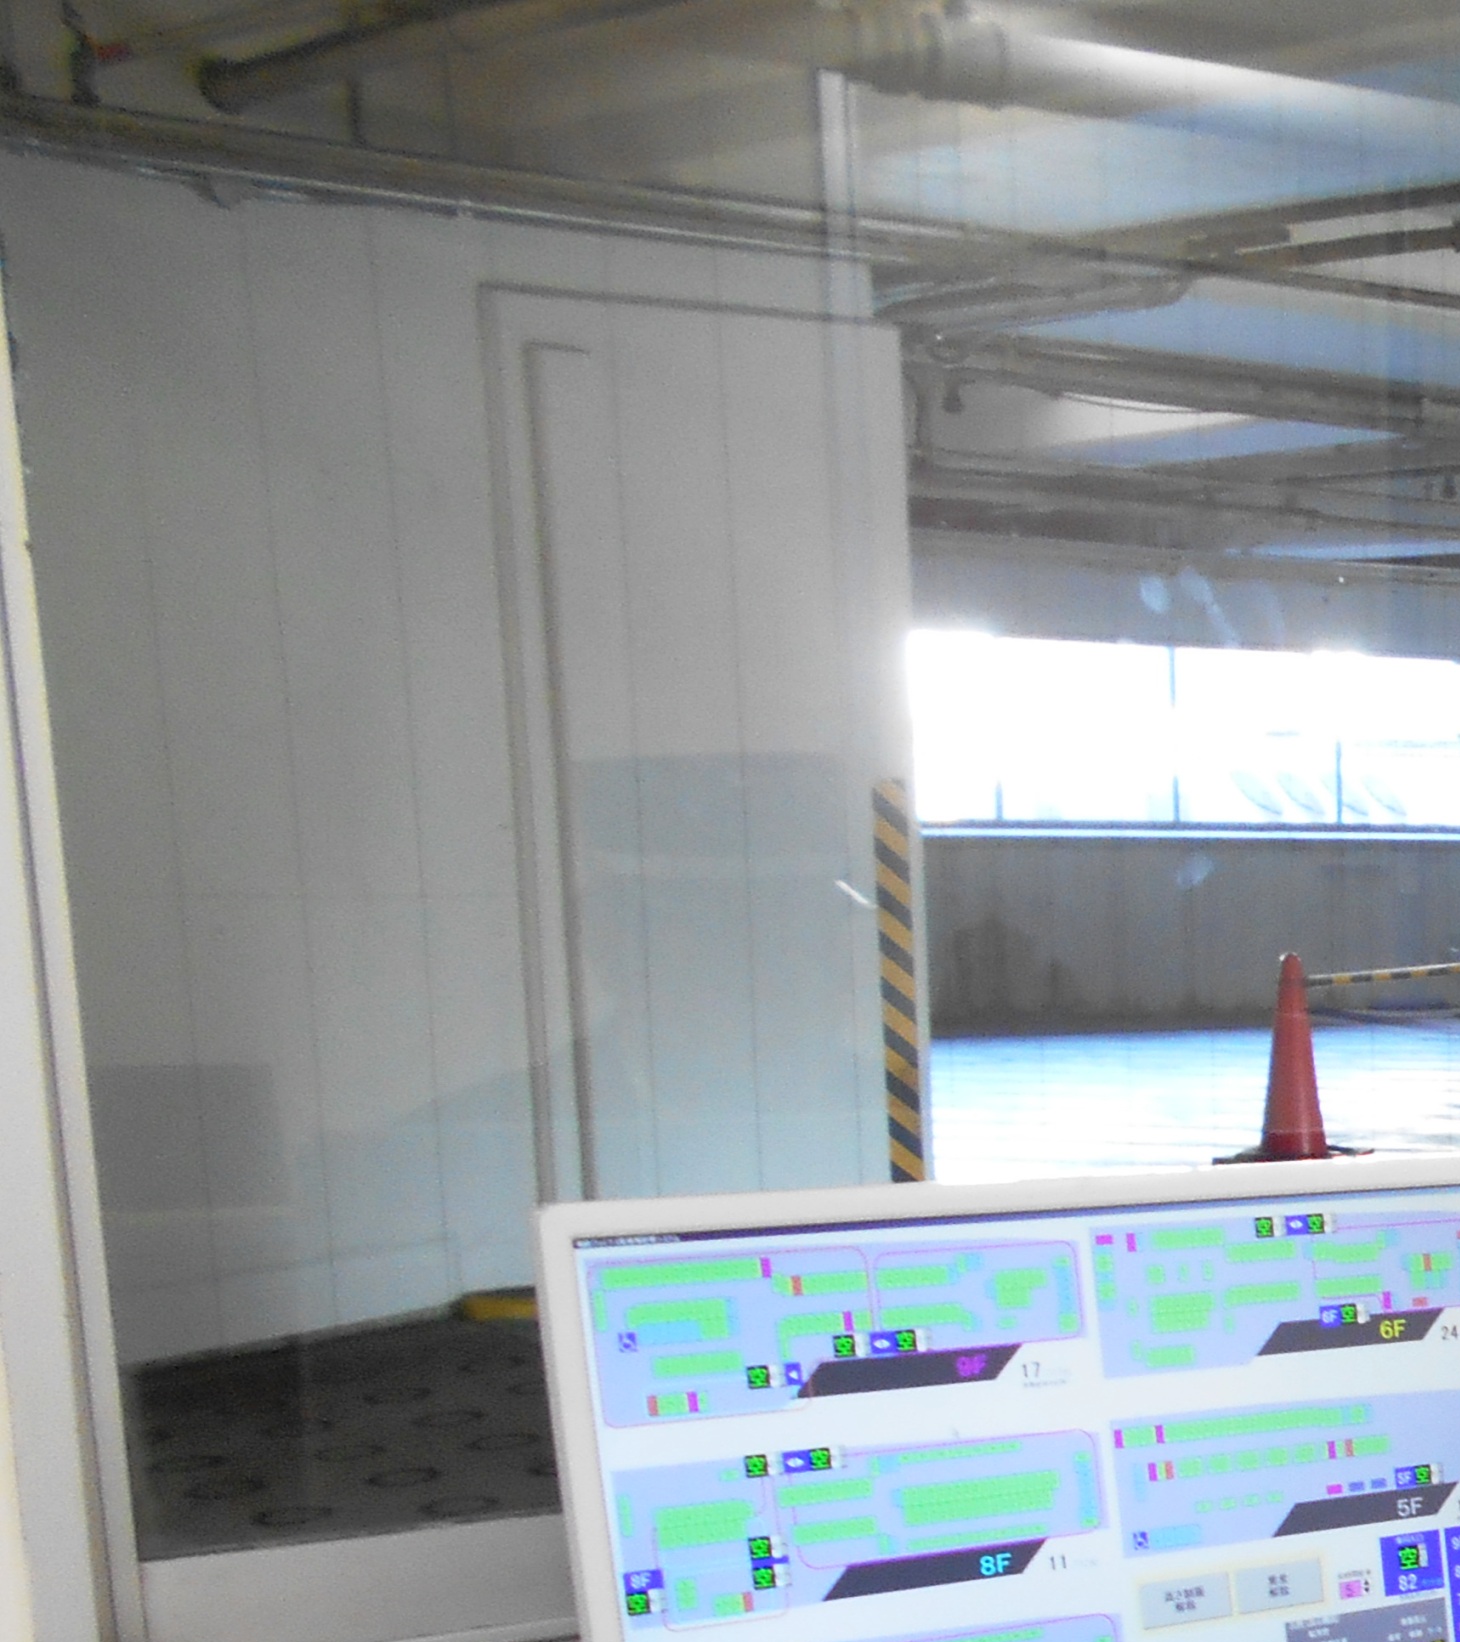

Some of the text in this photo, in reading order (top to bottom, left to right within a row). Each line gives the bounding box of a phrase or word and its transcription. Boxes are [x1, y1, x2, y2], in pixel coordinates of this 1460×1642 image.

[1380, 1319, 1459, 1340] 6F 24
[1021, 1363, 1041, 1380] 17
[1397, 1497, 1423, 1517] 5F
[979, 1553, 1068, 1576] 8F 11
[1399, 1547, 1419, 1570] 空
[1398, 1574, 1418, 1592] 82
